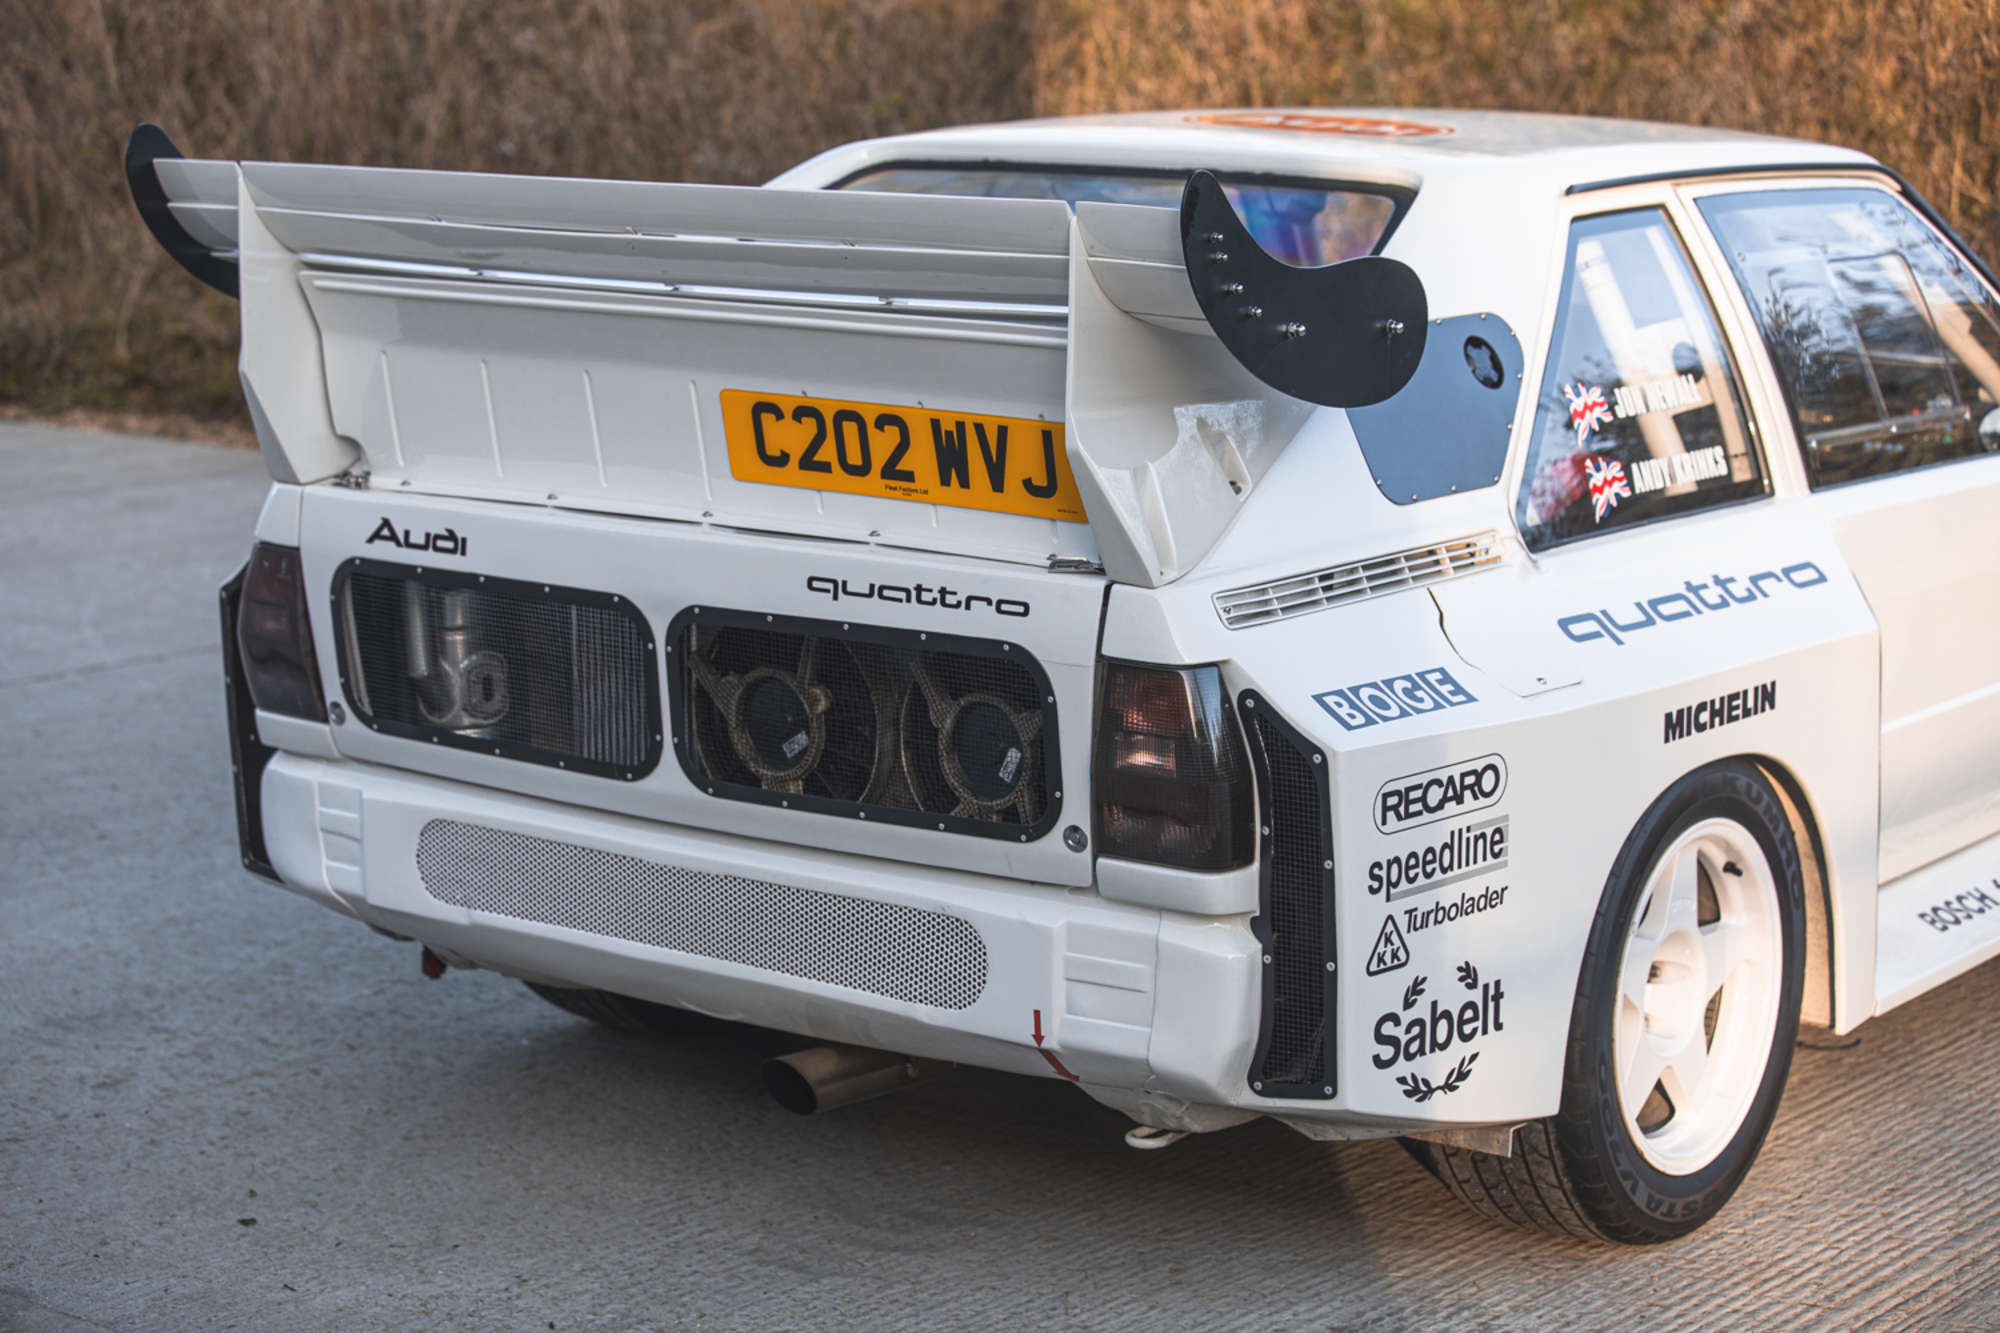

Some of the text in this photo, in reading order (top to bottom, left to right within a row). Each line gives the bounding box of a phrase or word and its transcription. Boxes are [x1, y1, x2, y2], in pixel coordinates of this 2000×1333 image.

[751, 401, 1058, 499] C202 WVJ
[1631, 459, 1671, 494] ANDY
[365, 516, 467, 556] Audi
[807, 576, 1030, 617] quattro
[1557, 561, 1828, 646] quattro
[1318, 669, 1471, 728] BOGE
[1663, 680, 1777, 744] MICHELIN
[1380, 763, 1501, 826] RECARO
[1367, 825, 1505, 902] speedline
[1403, 886, 1509, 934] Turbolader
[1917, 887, 2000, 933] BOSCH
[1371, 979, 1505, 1070] Sabelt
